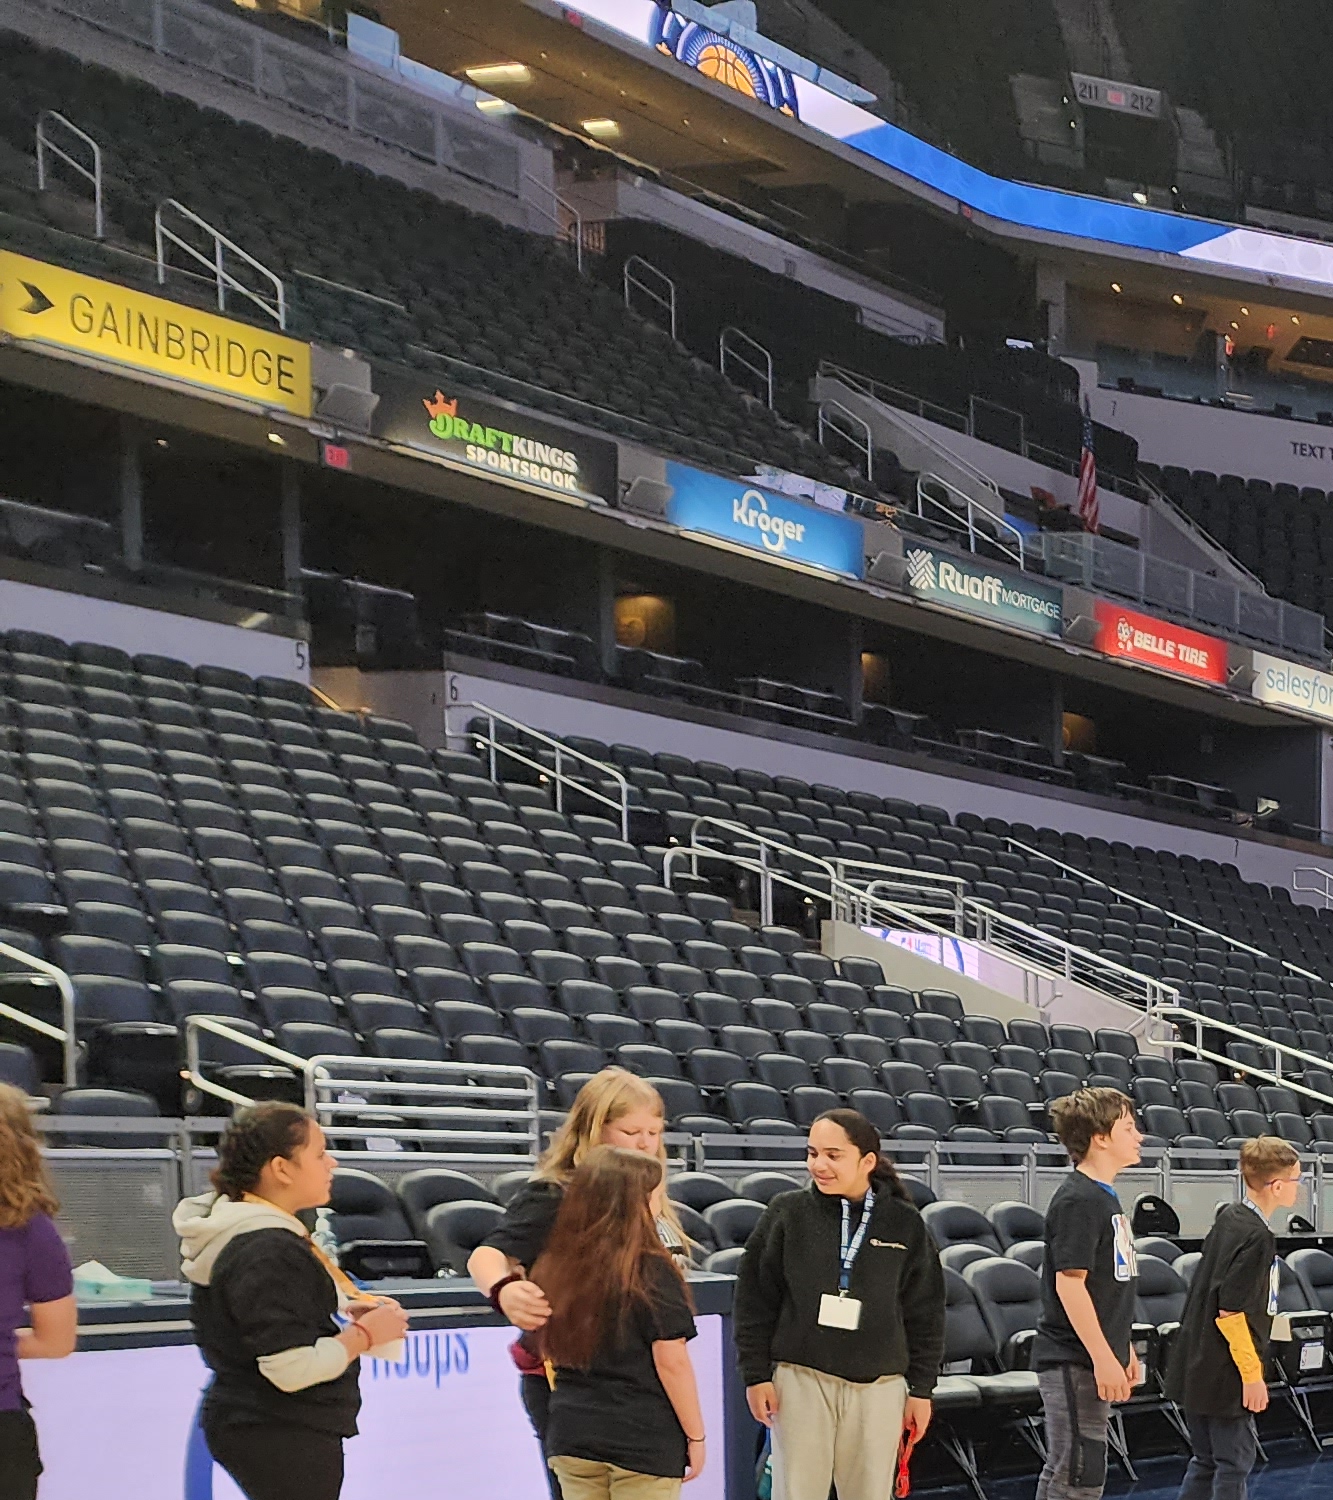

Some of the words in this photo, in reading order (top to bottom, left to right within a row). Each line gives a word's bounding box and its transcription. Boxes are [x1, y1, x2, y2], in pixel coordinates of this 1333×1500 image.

[1078, 82, 1098, 100] 211
[1130, 93, 1153, 112] 212
[69, 294, 295, 395] GAINBRIDGE
[430, 412, 578, 474] DRAFTKINGS
[1290, 441, 1326, 459] TEXT
[465, 444, 578, 492] SPORTSBOOK
[733, 489, 805, 553] Kroger
[938, 559, 1003, 605] Ruoff
[1001, 588, 1061, 620] MORTGAGE
[296, 642, 305, 670] 5
[1133, 630, 1176, 658] BELLE
[1176, 641, 1209, 669] TIRE
[450, 674, 458, 701] 6
